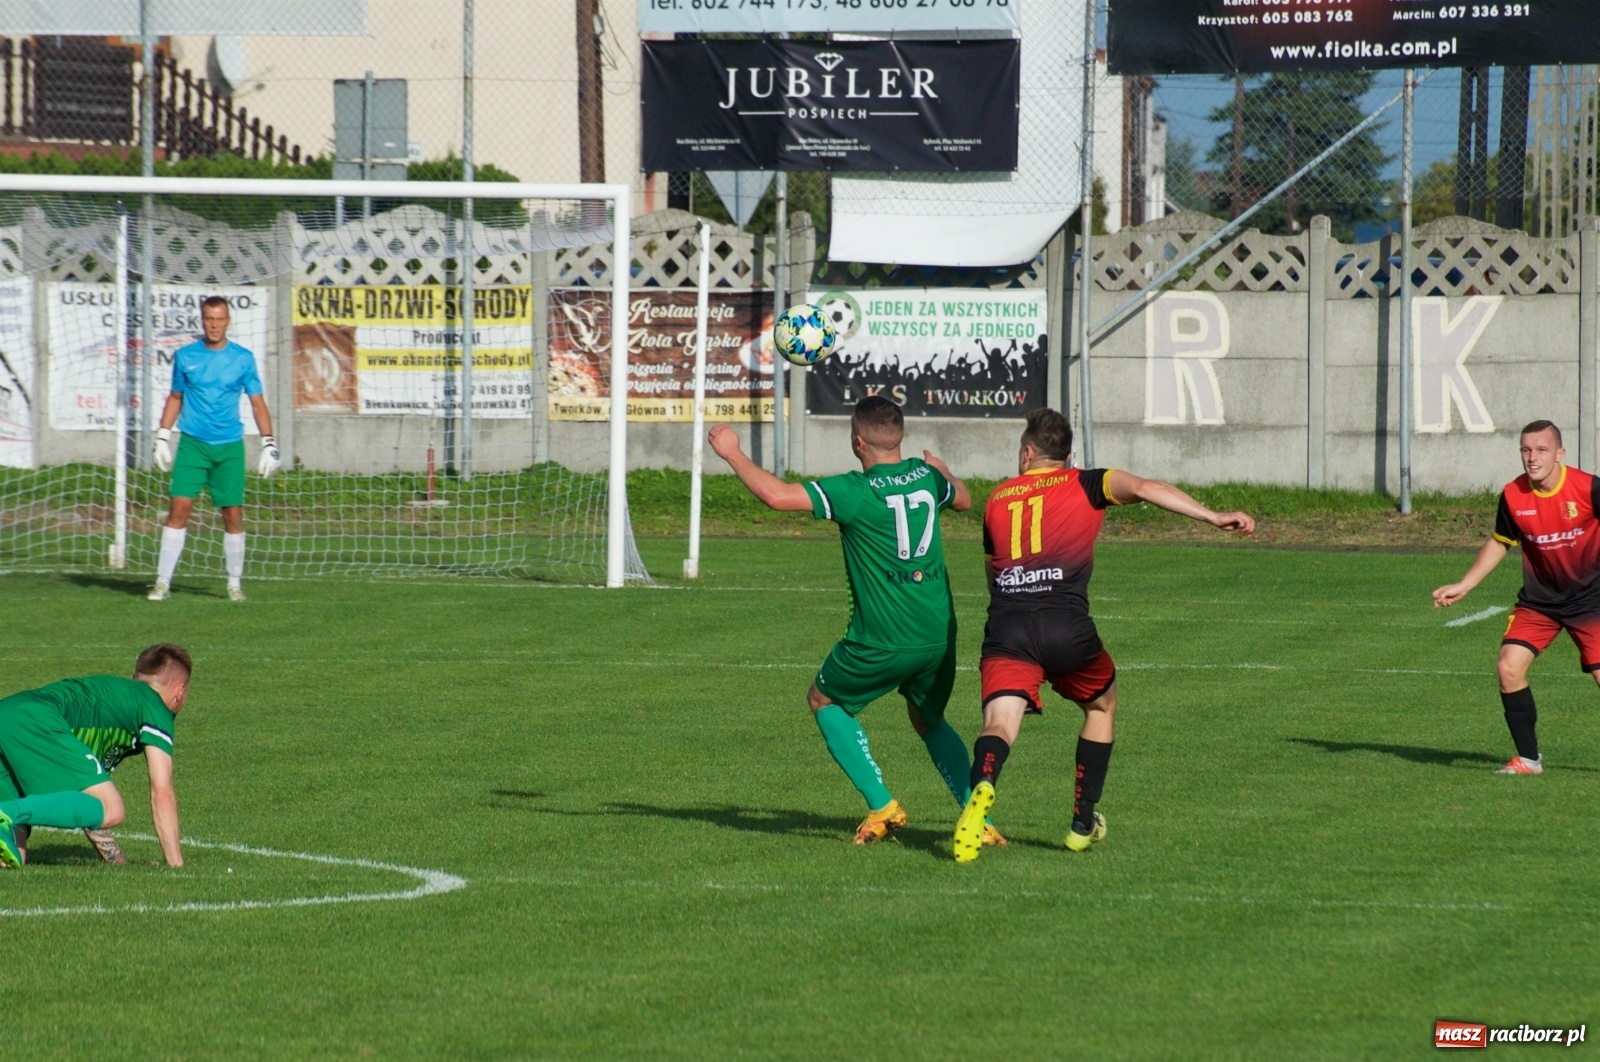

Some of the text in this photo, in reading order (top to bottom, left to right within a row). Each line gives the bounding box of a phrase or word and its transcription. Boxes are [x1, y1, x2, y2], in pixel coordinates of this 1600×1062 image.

[1198, 10, 1353, 27] Krzysztof: 605 083 762
[1393, 4, 1530, 20] Marcin: 607 336 321
[1271, 37, 1457, 60] www.fiolka.com.pl
[61, 291, 136, 306] USŁUI
[866, 300, 1038, 318] JEDEN ZA WSZYSTKICH
[868, 321, 1035, 338] WSZYSCY ZA JEDNEGO
[367, 354, 531, 367] www.oknadrzwschody.pl
[1144, 290, 1229, 425] R
[1411, 295, 1503, 433] K
[924, 385, 1027, 406] TWORKÓW
[672, 405, 683, 415] 11
[715, 404, 735, 416] 798
[739, 404, 758, 415] 441
[885, 489, 935, 560] 17
[1007, 494, 1044, 561] 11
